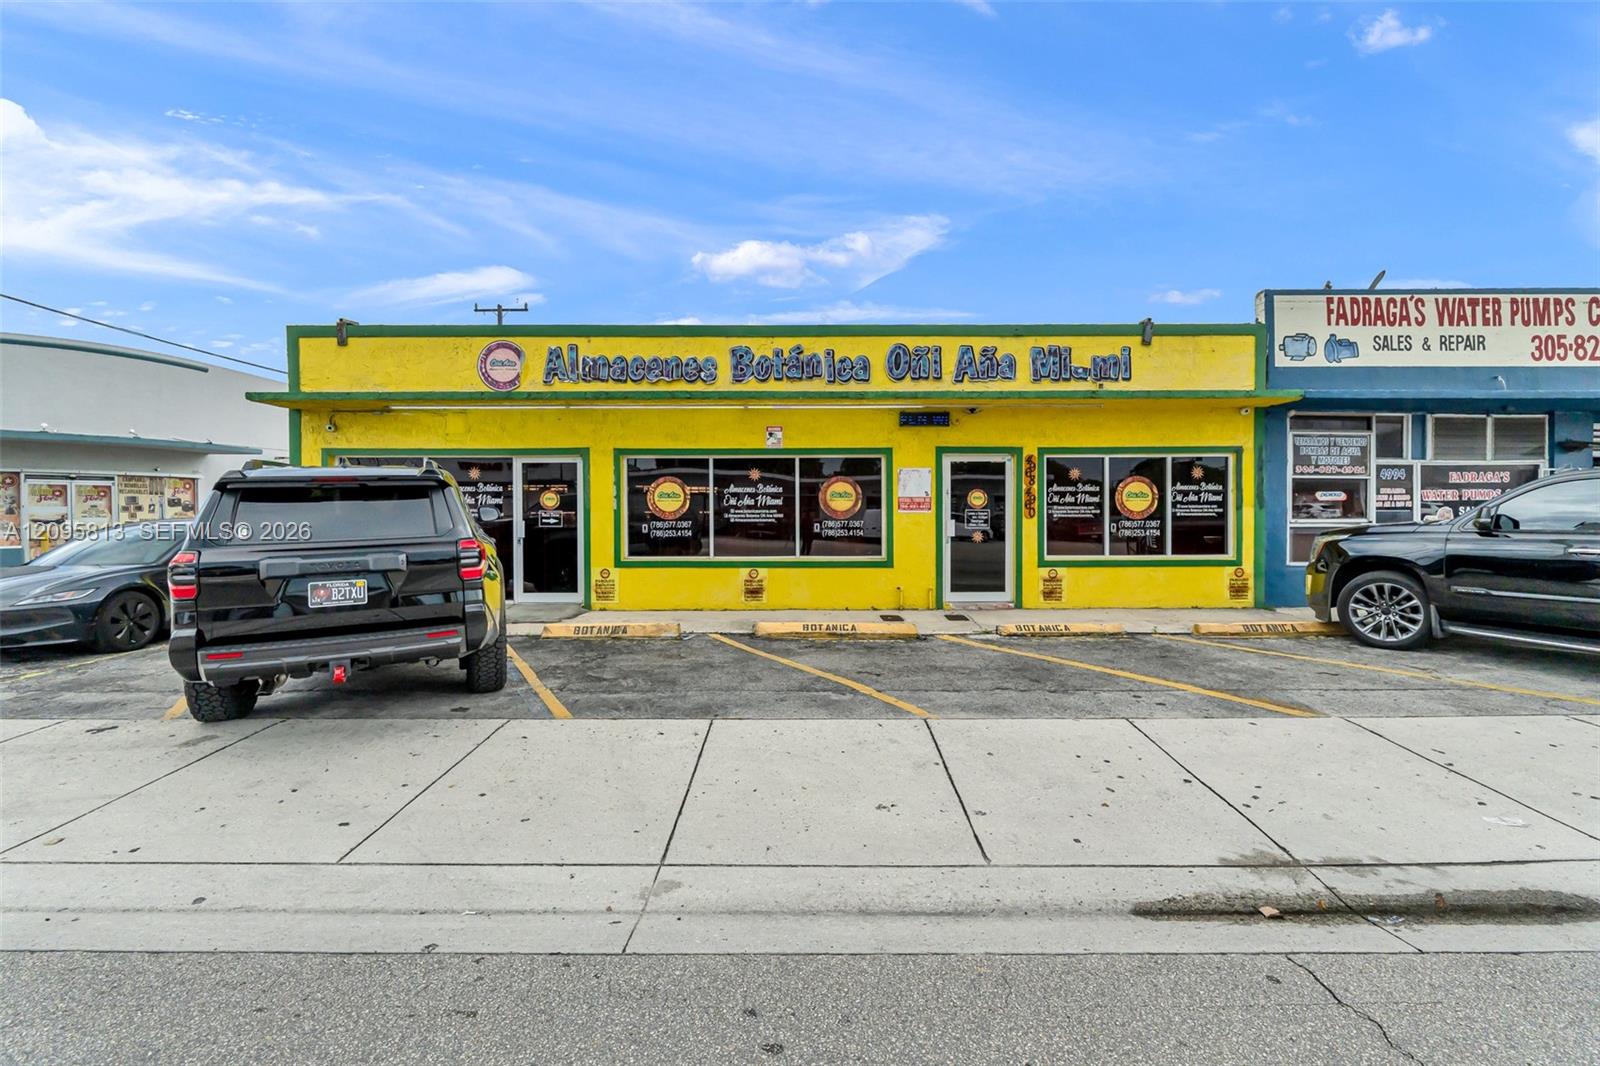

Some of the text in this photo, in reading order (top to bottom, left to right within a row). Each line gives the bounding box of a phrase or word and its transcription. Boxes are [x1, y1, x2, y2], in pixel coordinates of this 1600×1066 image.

[1325, 294, 1426, 327] FADRAGA'S
[1435, 297, 1502, 327] WATER
[1510, 296, 1576, 327] PUMPS
[1373, 335, 1486, 352] SALES & REPAIR
[542, 344, 718, 385] Almacenes
[730, 344, 870, 384] Botánica
[885, 342, 942, 381] Oñi
[952, 344, 1017, 384] Aña
[1300, 447, 1328, 455] BOMBAS
[1341, 447, 1361, 456] AGUA
[1380, 468, 1406, 480] 4994
[1449, 472, 1510, 483] FADRAGA'S
[724, 483, 756, 494] Almacenes
[1421, 489, 1459, 501] WATER
[1462, 489, 1500, 500] PUMPS
[756, 495, 784, 507] Miami
[650, 521, 692, 529] (786)577.0367
[822, 521, 864, 529] (786)577.0367
[1118, 520, 1160, 529] (786)577.0367
[650, 530, 692, 538] (786)253.4154
[822, 529, 864, 538] (786)253.4154
[1118, 529, 1160, 538] (786)253.4154
[332, 586, 364, 600] B2TXU
[1242, 624, 1299, 632] BOTANICA
